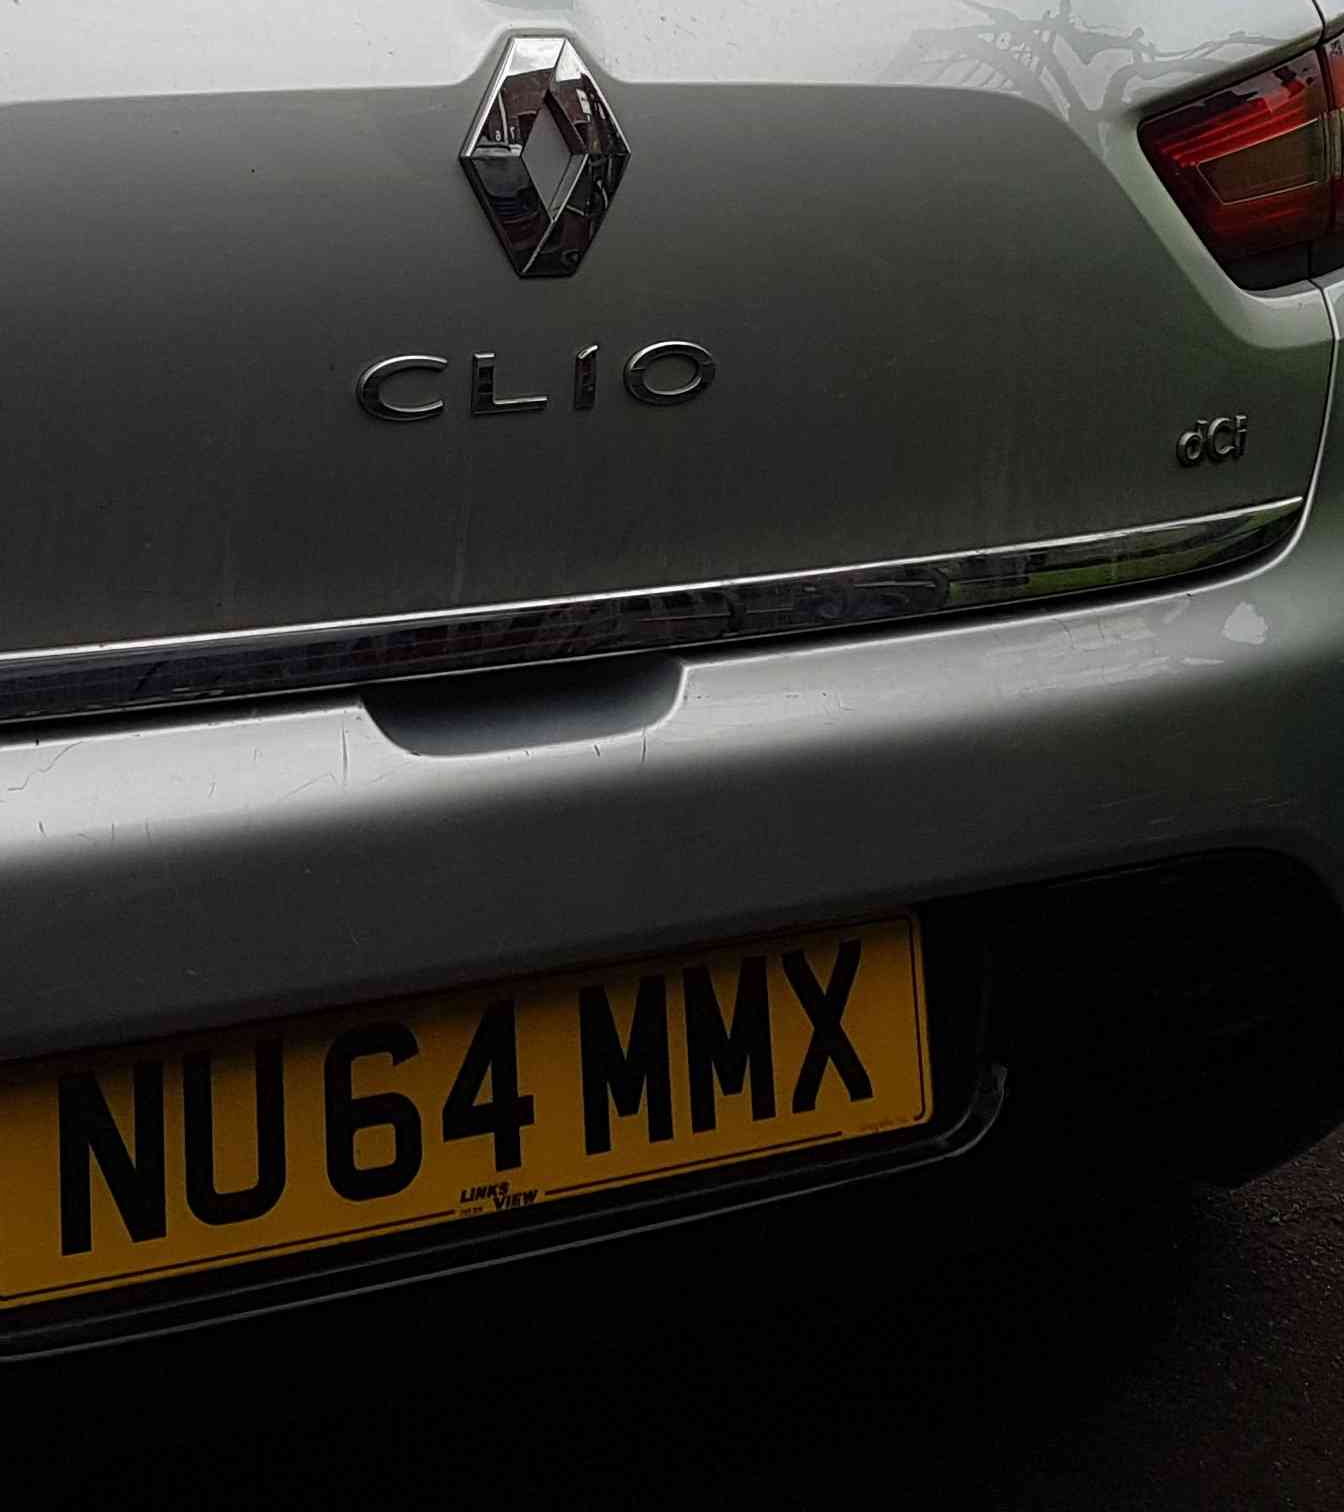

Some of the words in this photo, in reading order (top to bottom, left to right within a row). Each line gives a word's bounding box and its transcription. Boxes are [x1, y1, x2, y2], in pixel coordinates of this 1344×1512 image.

[357, 340, 717, 422] CLIO
[1176, 414, 1249, 467] dCi
[58, 997, 535, 1256] NU64
[579, 938, 874, 1155] MMX
[460, 1181, 510, 1203] LINKS
[494, 1189, 539, 1208] VIEW
